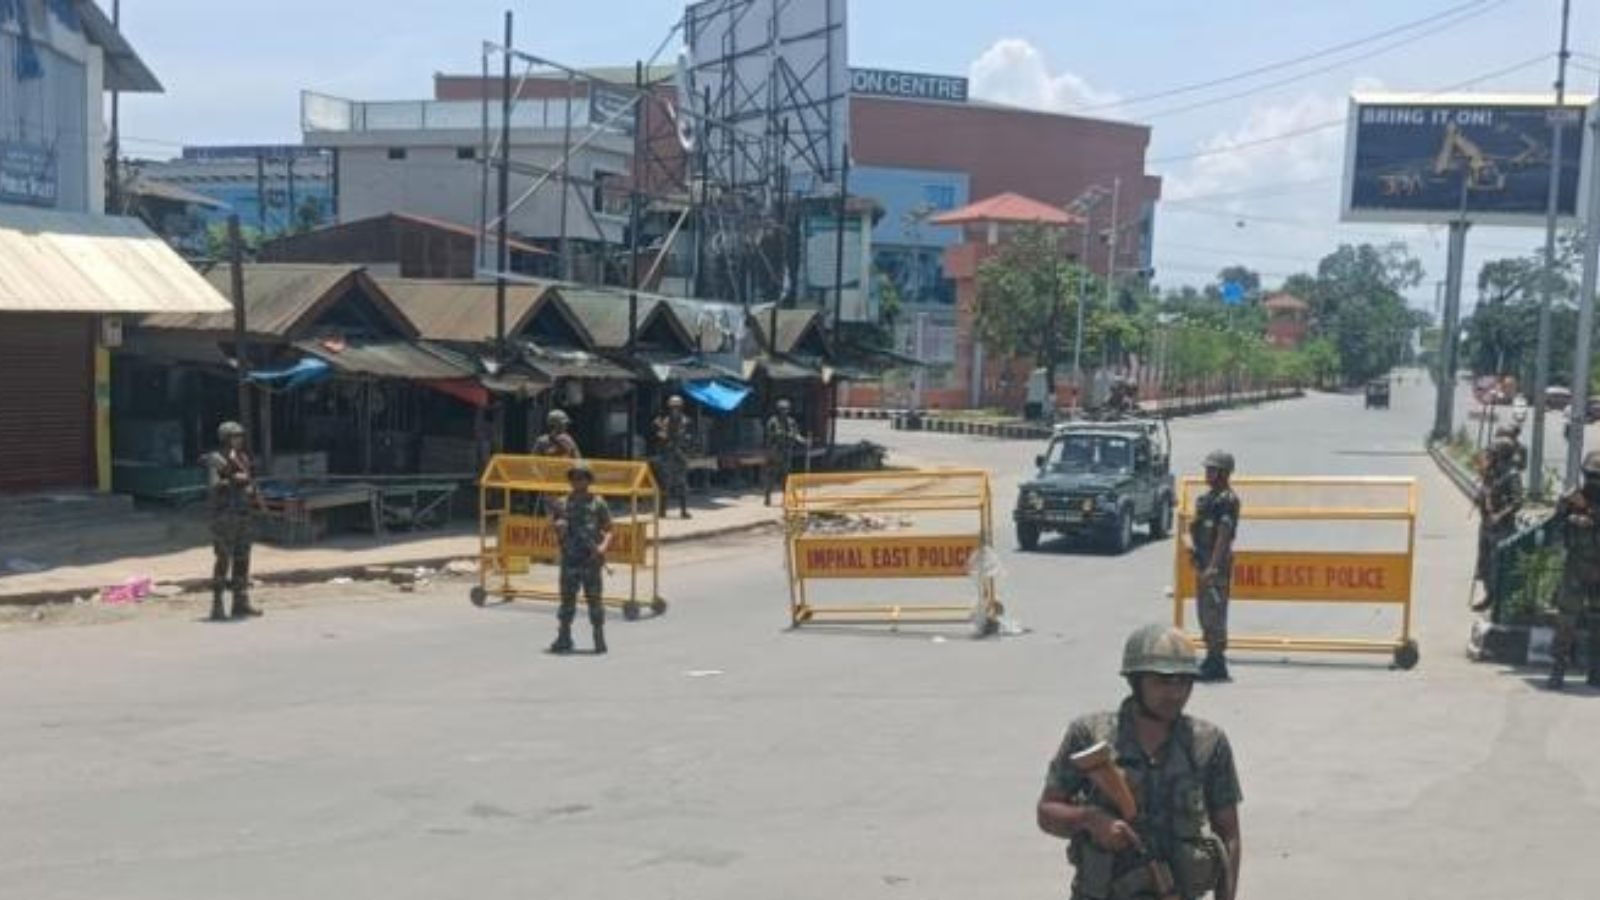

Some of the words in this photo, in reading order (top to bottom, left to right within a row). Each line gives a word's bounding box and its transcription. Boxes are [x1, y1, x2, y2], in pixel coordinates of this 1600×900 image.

[852, 71, 882, 91] ON
[885, 75, 964, 99] CENTRE
[1362, 107, 1424, 125] BRING
[1431, 108, 1449, 125] IT
[1456, 108, 1492, 126] ON!
[807, 547, 864, 569] IMPHAL
[872, 546, 911, 568] EAST
[1234, 563, 1267, 587] HAL
[1272, 564, 1314, 587] EAST
[1327, 565, 1386, 589] POLICE
